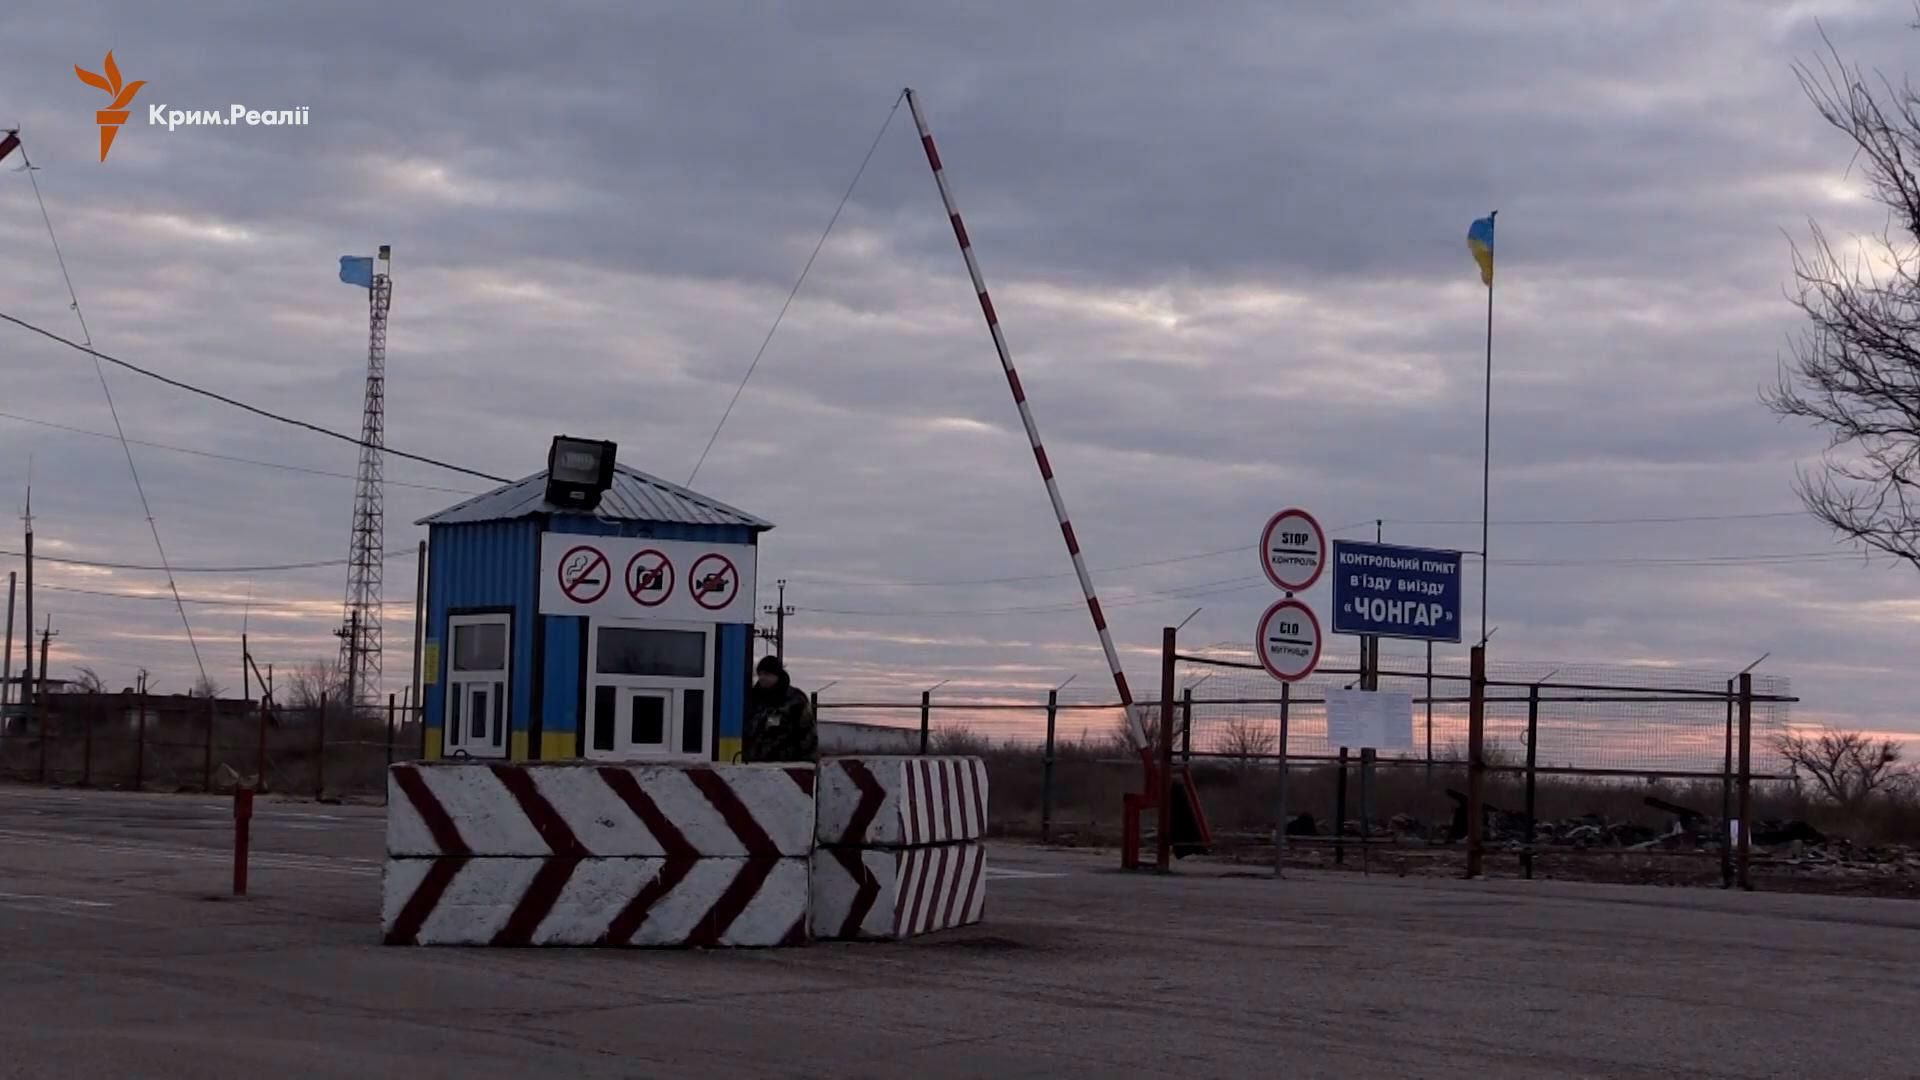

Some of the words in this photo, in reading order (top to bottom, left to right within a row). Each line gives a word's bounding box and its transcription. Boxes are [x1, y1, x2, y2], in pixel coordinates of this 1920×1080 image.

[1281, 532, 1309, 545] STOP
[1340, 552, 1420, 571] КОНТРОЛЬНИЙ
[1422, 561, 1457, 574] ПУНКТ
[1398, 578, 1445, 596] ВИЇЗДУ
